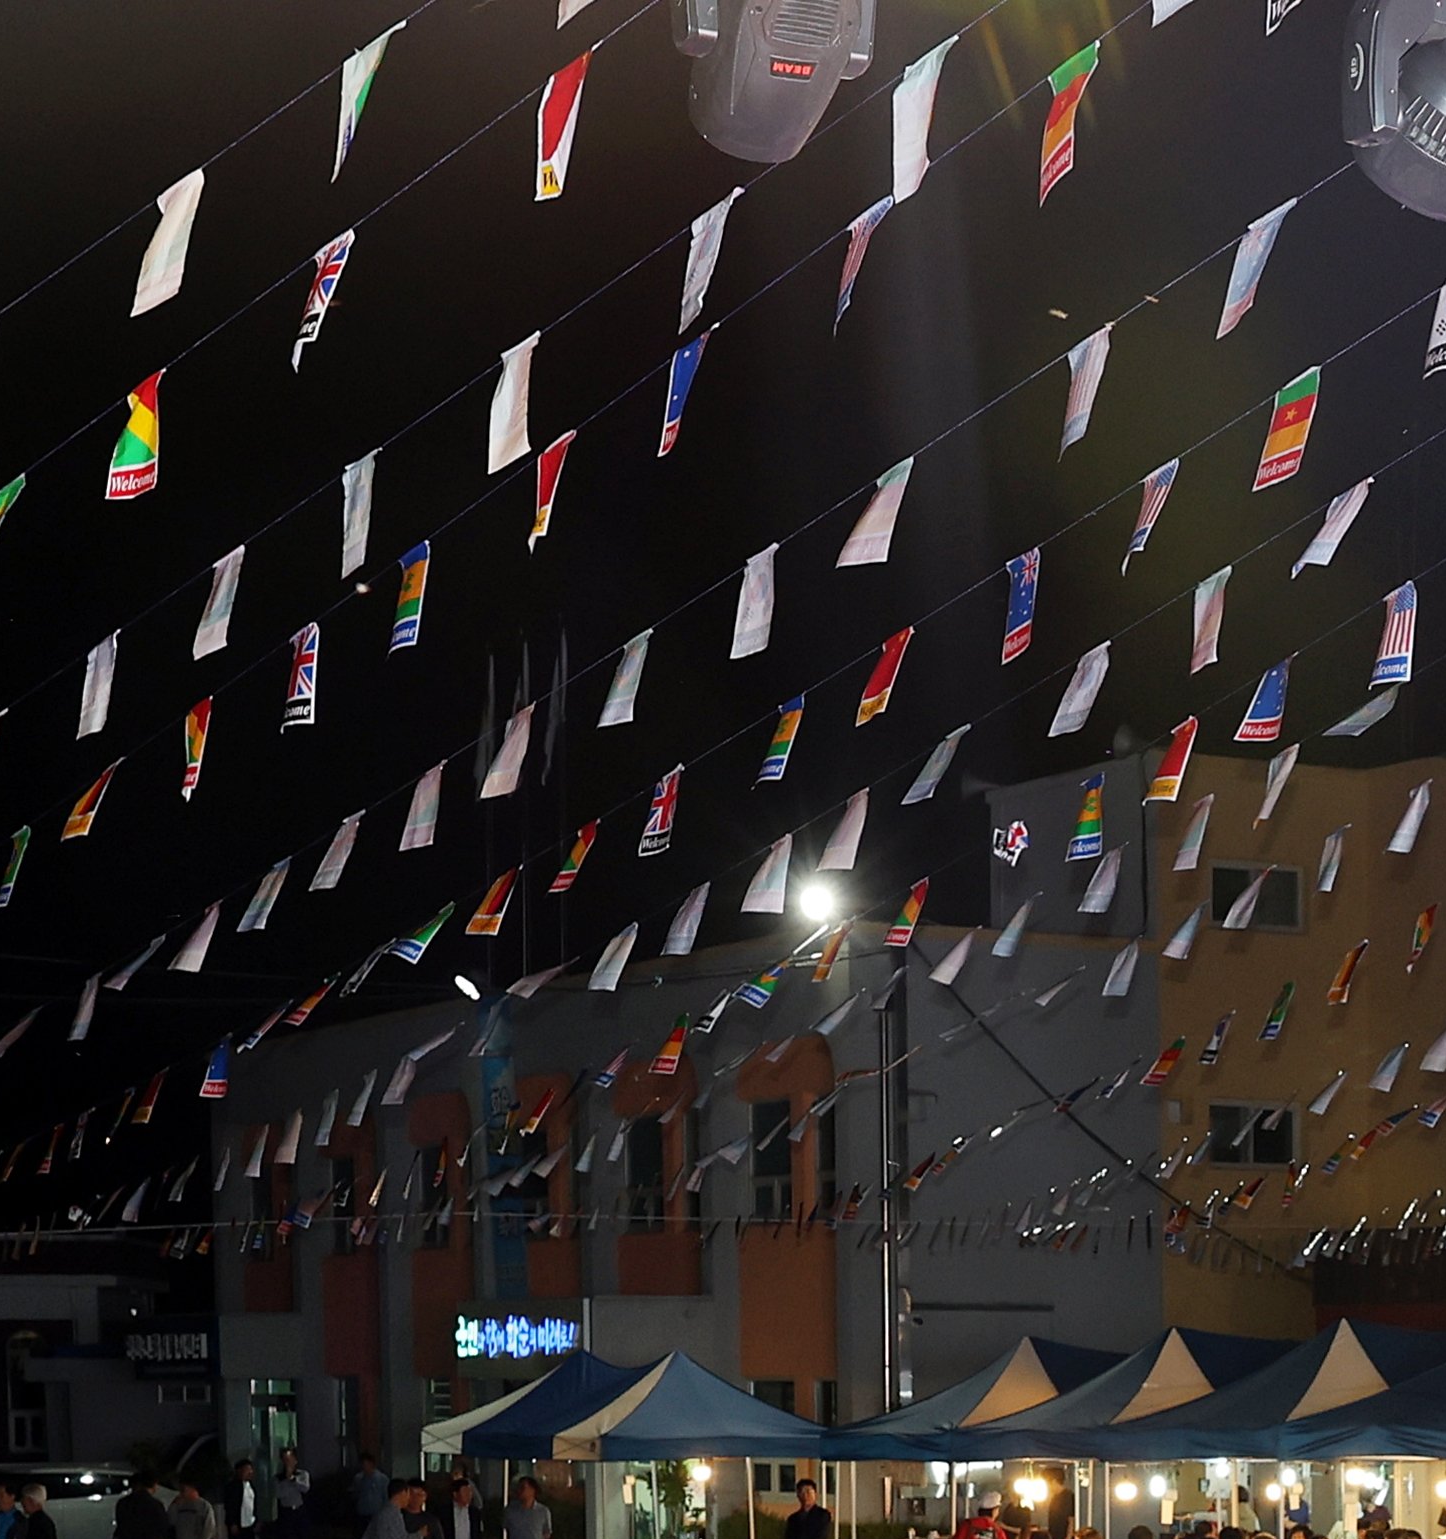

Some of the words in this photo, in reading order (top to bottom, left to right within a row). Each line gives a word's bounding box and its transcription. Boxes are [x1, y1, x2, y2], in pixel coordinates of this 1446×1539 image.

[772, 61, 812, 76] BEAM
[1257, 454, 1300, 480] Welcome
[111, 470, 156, 493] Welcome
